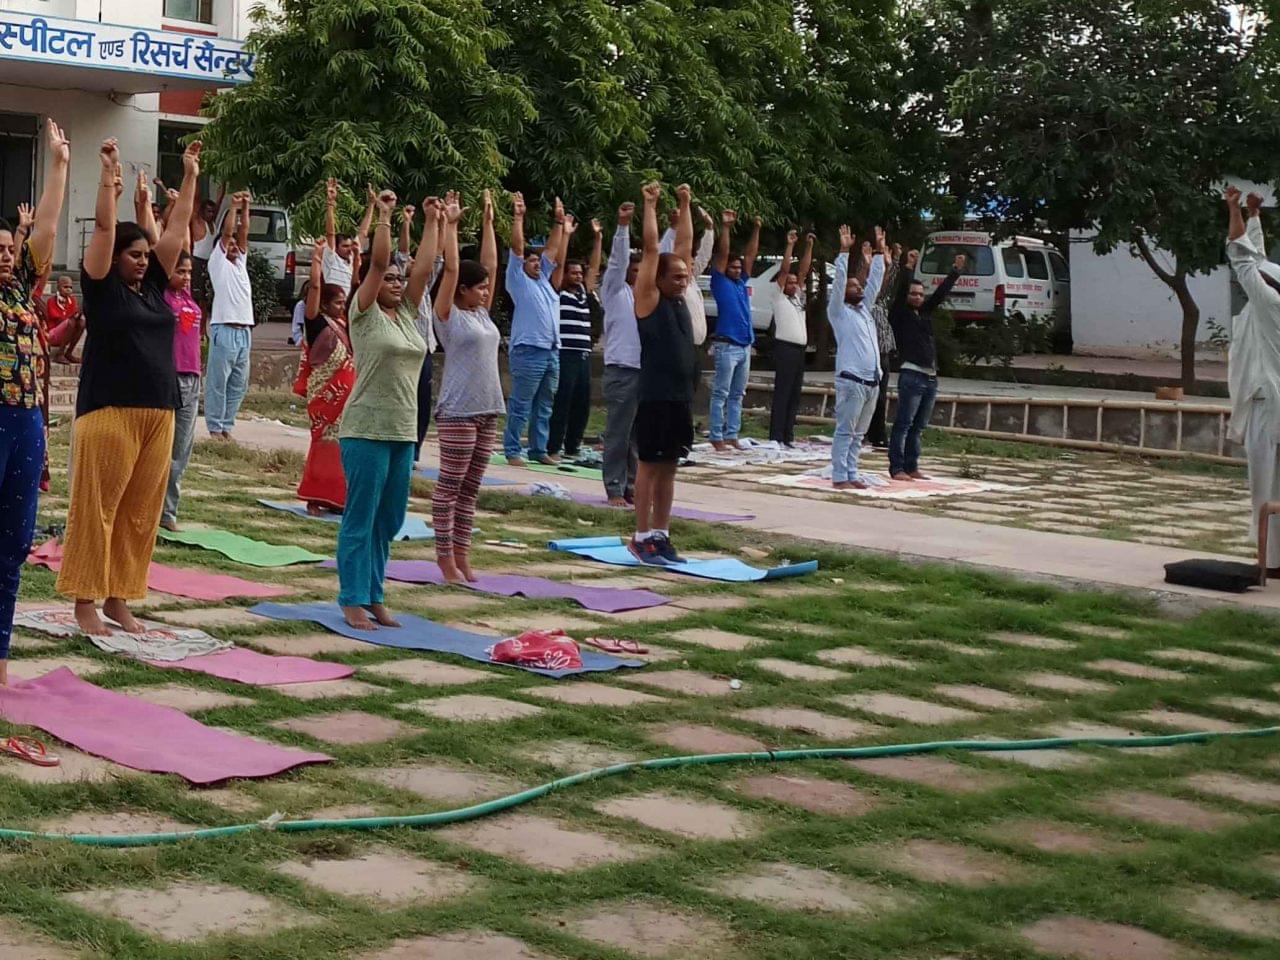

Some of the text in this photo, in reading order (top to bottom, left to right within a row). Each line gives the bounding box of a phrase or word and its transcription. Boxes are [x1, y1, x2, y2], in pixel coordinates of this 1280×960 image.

[99, 40, 124, 60] एण्ड
[131, 31, 194, 70] रिसर्च
[931, 277, 980, 289] AMANCE
